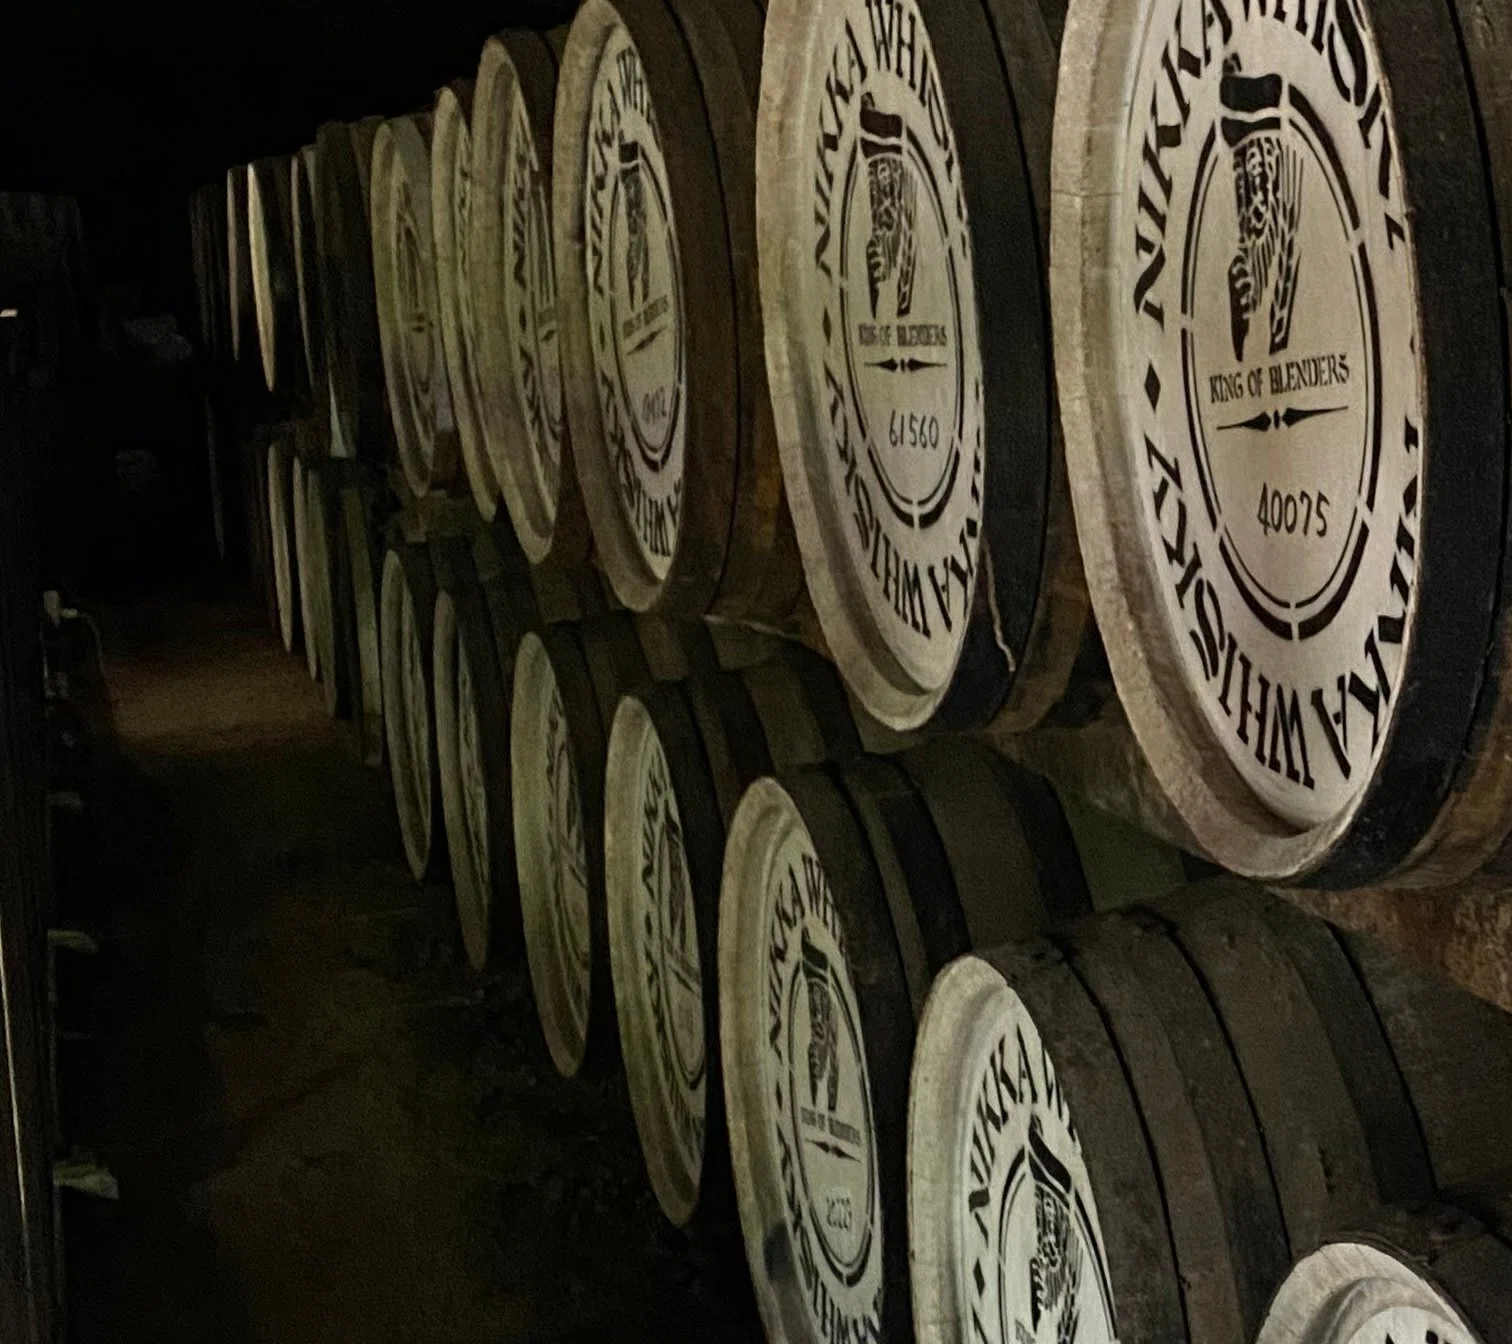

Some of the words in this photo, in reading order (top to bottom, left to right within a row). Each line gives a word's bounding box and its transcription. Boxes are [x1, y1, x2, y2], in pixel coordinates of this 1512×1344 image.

[814, 17, 868, 279] NIKKA
[889, 408, 939, 450] 61560
[1209, 371, 1244, 405] KING
[1247, 367, 1264, 399] OF
[1268, 352, 1350, 397] BLENDERS
[823, 360, 931, 639] WHISKY
[1143, 433, 1315, 790] WHISKY
[1256, 481, 1331, 538] 40075
[969, 1022, 1038, 1249] NIKKA
